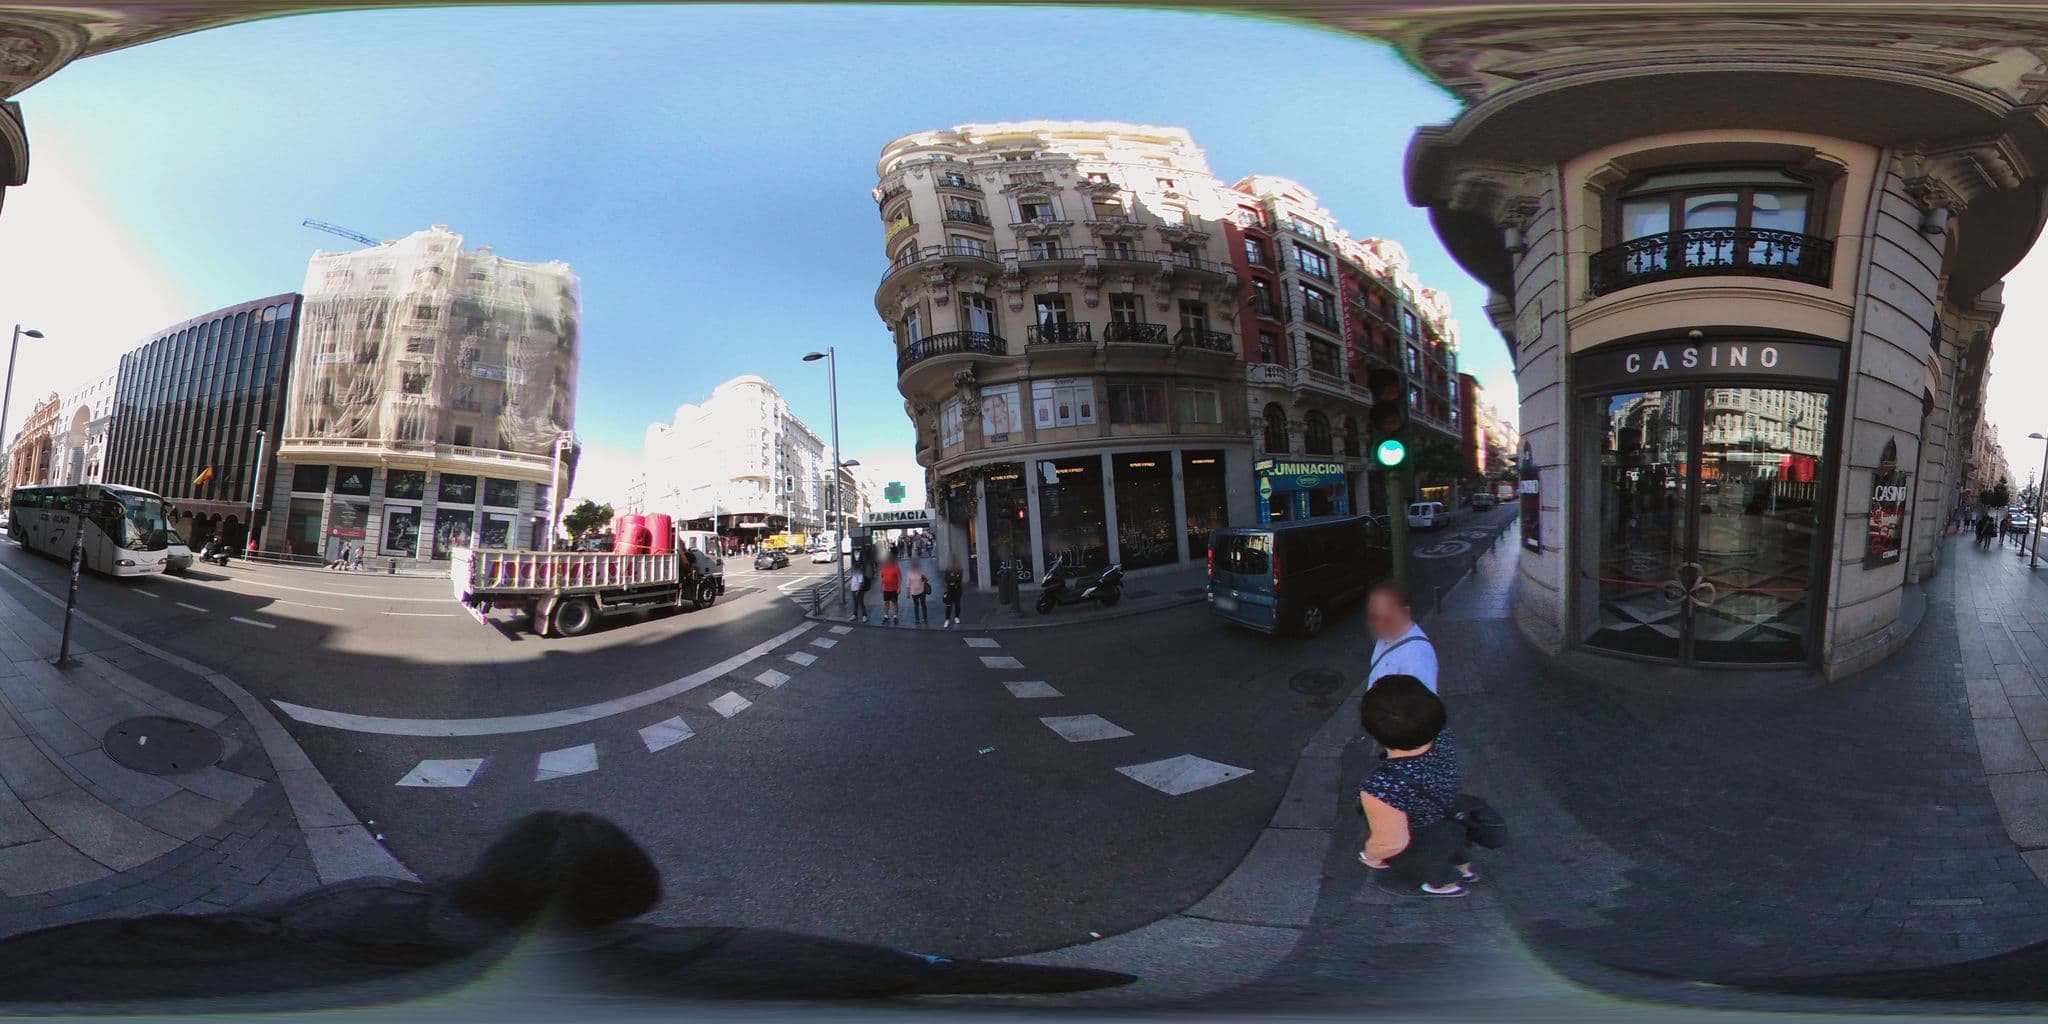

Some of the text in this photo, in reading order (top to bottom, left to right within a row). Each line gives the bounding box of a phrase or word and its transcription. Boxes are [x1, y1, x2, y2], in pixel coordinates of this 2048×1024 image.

[1625, 346, 1779, 374] CASINO
[1267, 463, 1344, 476] UMINACION
[1875, 485, 1907, 502] CASINO
[869, 510, 928, 522] FARMACIA
